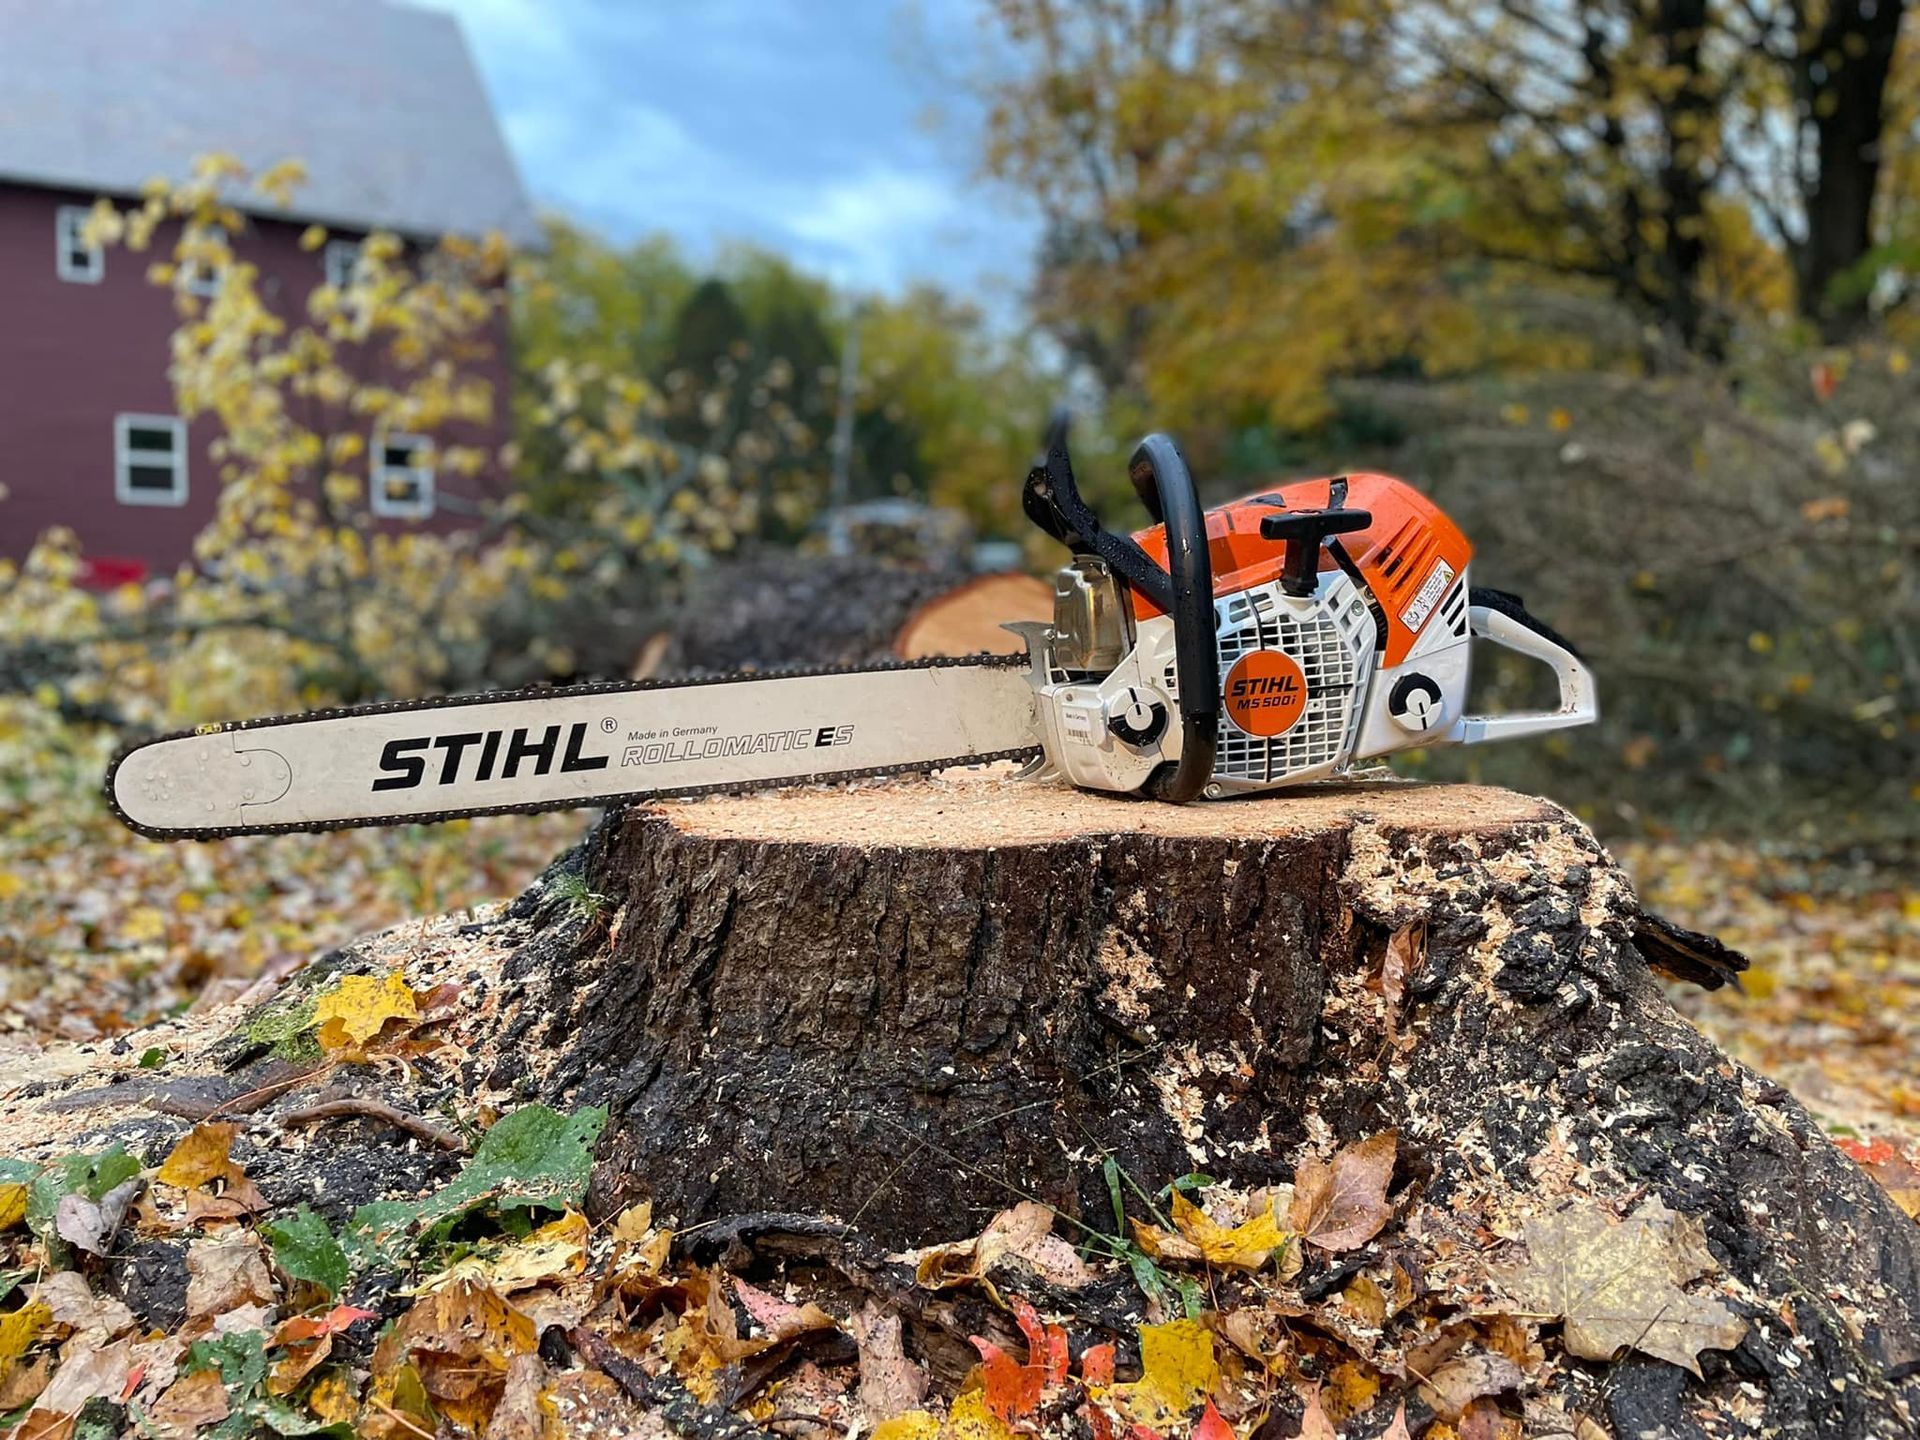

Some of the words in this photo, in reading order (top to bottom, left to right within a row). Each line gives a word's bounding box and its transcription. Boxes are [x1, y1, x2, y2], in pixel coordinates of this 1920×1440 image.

[1231, 675, 1299, 697] STIHL
[1237, 698, 1260, 710] MS
[627, 730, 656, 741] Made
[659, 728, 669, 738] in
[672, 725, 718, 738] Germany
[371, 722, 610, 791] STIHL
[621, 729, 811, 767] ROLLOMATIC
[814, 725, 855, 747] ES
